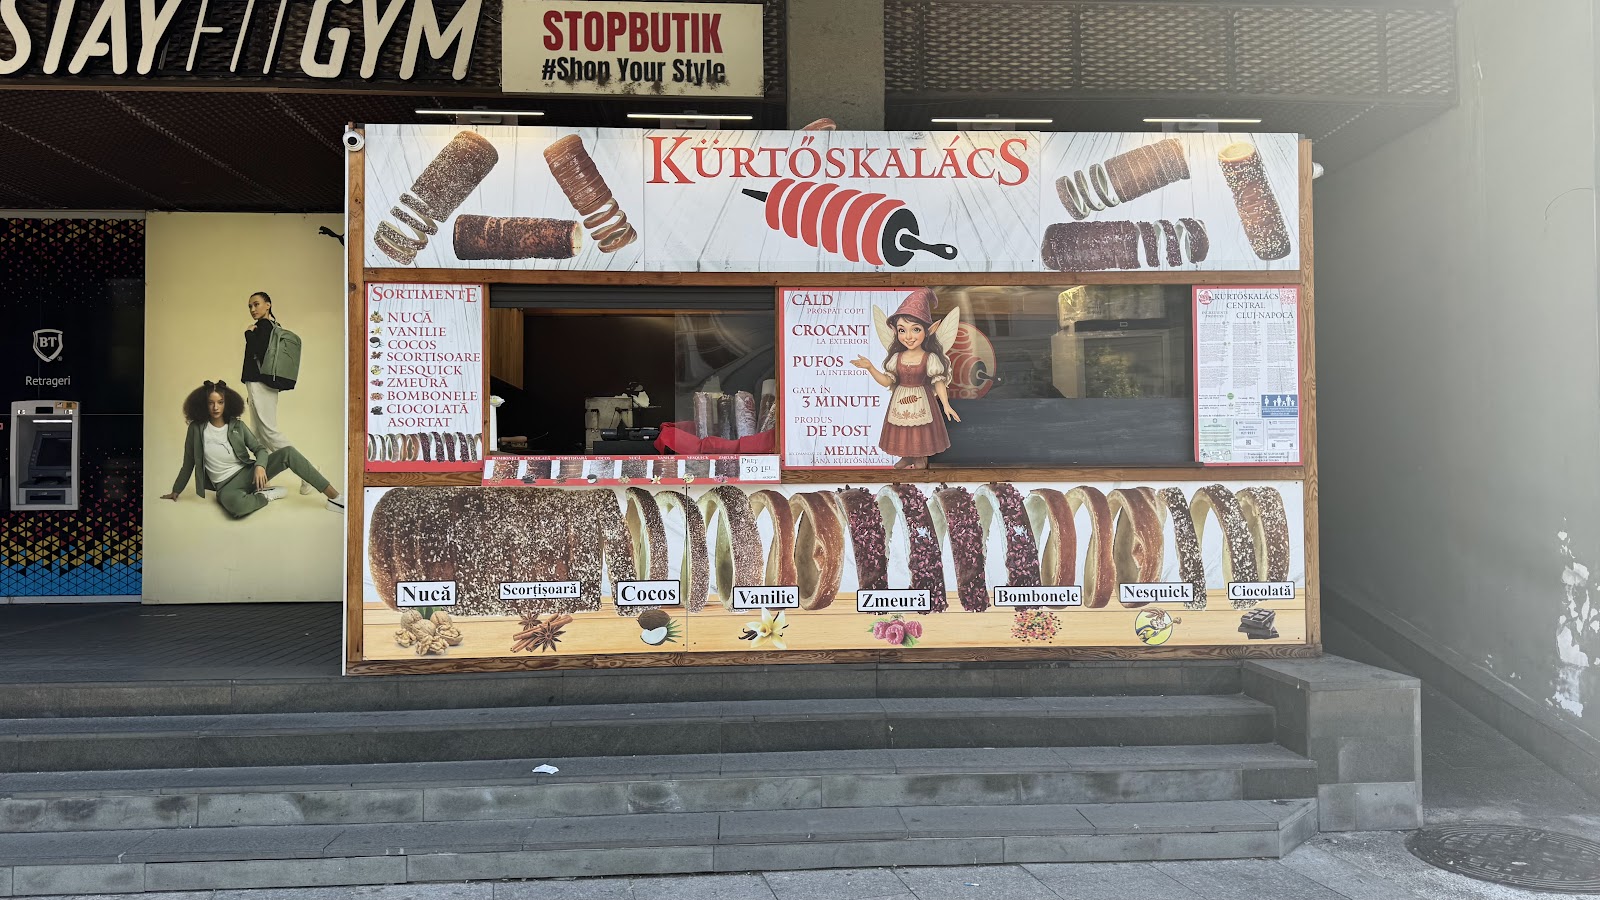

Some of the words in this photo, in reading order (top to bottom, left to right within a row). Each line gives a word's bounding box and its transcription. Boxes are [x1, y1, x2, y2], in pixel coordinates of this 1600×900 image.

[543, 10, 723, 54] STOPBUTIK
[300, 0, 484, 81] GYM
[541, 57, 610, 84] #Shop
[617, 58, 666, 82] Your
[672, 58, 726, 86] Style
[645, 134, 1030, 187] KÜRTŐSKALÁCS
[372, 286, 477, 303] SORTIMENTE
[791, 293, 834, 306] CALD
[387, 309, 434, 324] NUCĂ
[1236, 311, 1294, 320] CLUJ-NAPOCA
[387, 326, 447, 337] VANILIE
[791, 324, 870, 337] CROCANT
[39, 336, 58, 348] BT
[387, 340, 437, 350] COCOS
[792, 355, 845, 368] PUFOS
[387, 365, 464, 378] NESQUICK
[25, 375, 71, 388] Retrageri
[386, 376, 449, 388] ZMEURĂ
[387, 390, 478, 402] BOMBONELE
[792, 386, 817, 394] GATA
[386, 402, 469, 414] CIOCOLATĂ
[802, 396, 811, 408] 3
[815, 395, 881, 408] MINUTE
[387, 417, 452, 428] ASORTAT
[794, 416, 833, 424] PRODUS
[806, 425, 828, 437] DE
[832, 425, 872, 437] POST
[823, 445, 879, 456] MELINA
[401, 585, 451, 602] Nucă
[502, 582, 577, 597] Scorțișoară
[621, 585, 676, 602] Cocos
[998, 588, 1078, 604] Bombonele
[1124, 584, 1189, 602] Nesquick
[1231, 584, 1291, 598] Ciocolată
[739, 590, 795, 605] Vanilie
[862, 592, 926, 608] Zmeură
